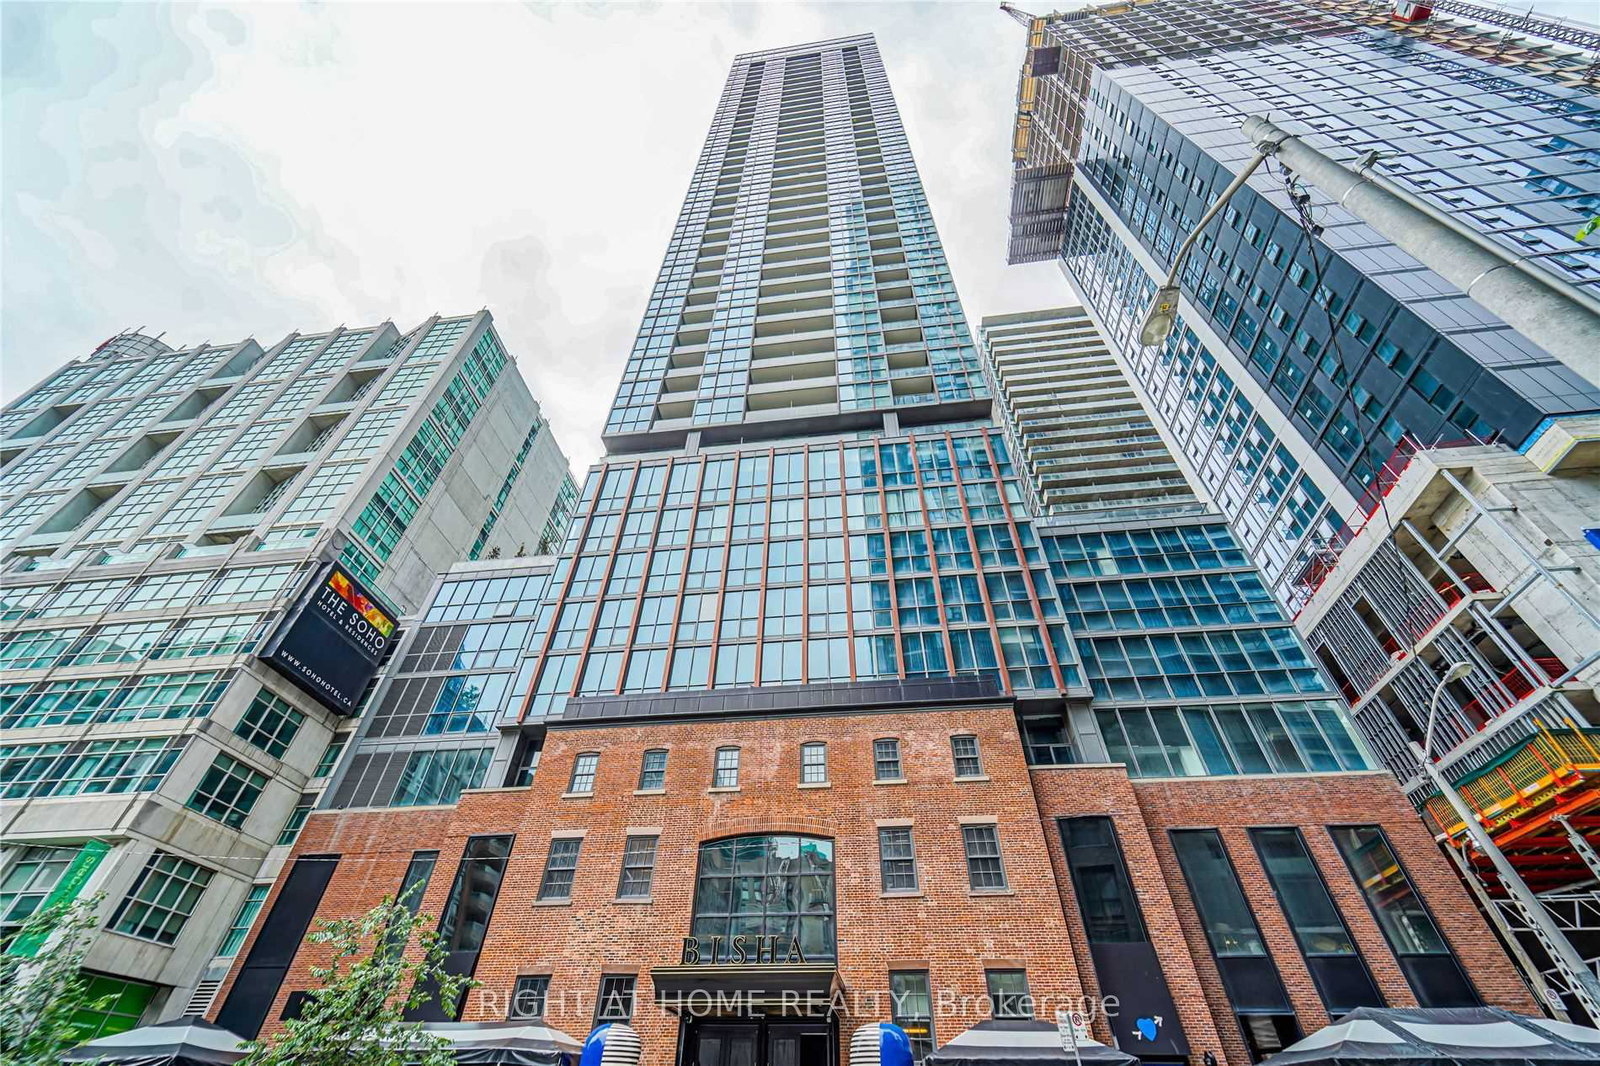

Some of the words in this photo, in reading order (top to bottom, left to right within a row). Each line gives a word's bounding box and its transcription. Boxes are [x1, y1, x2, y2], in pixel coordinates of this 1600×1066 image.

[317, 600, 338, 620] HOTEL
[344, 624, 378, 656] RESIDENCES
[320, 587, 348, 615] THE
[349, 613, 385, 649] SOHO
[281, 650, 352, 707] WWW.SOHOHOTEL.CA
[680, 934, 808, 965] BISHA
